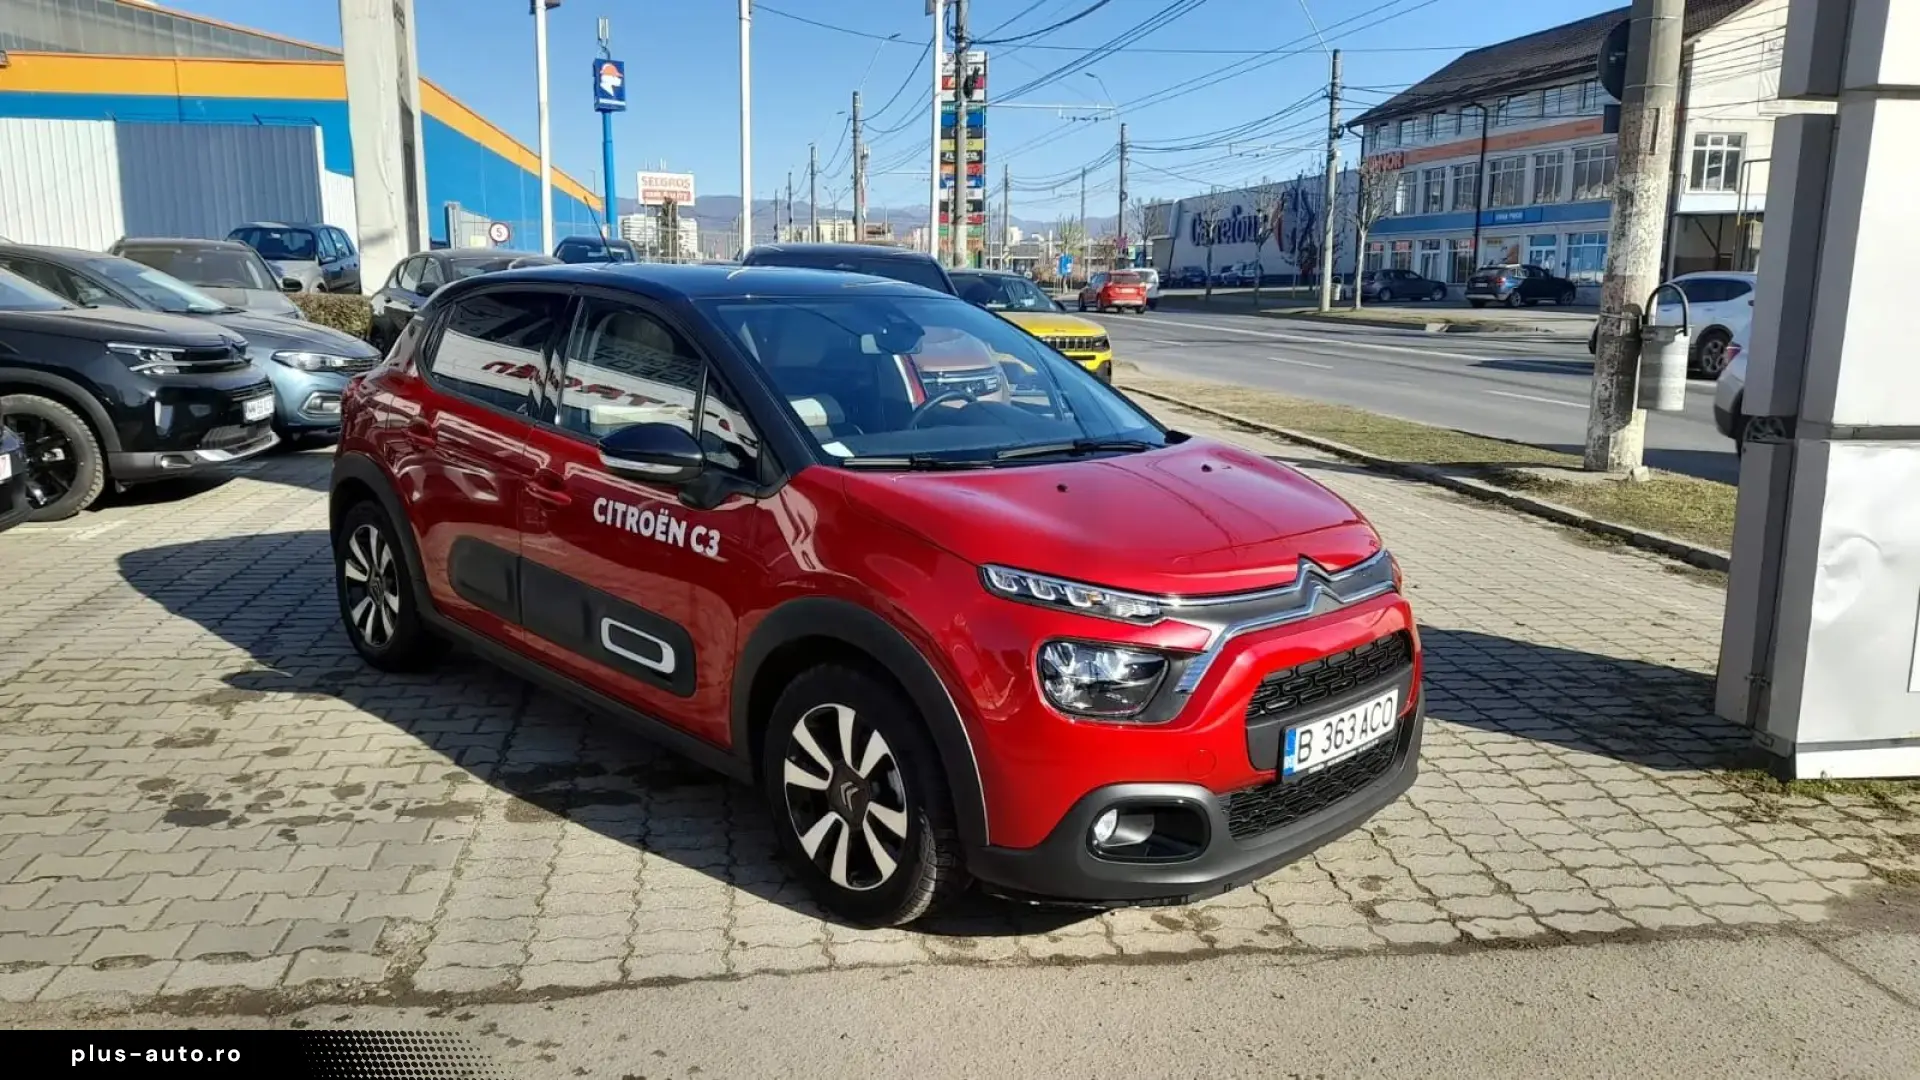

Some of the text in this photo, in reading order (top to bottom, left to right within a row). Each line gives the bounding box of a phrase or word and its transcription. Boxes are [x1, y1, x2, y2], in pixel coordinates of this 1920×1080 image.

[641, 175, 691, 189] SELGROS
[593, 497, 721, 557] CITROËN C3
[1298, 729, 1313, 764] B
[1321, 713, 1357, 754] 363
[1359, 697, 1393, 740] ACO
